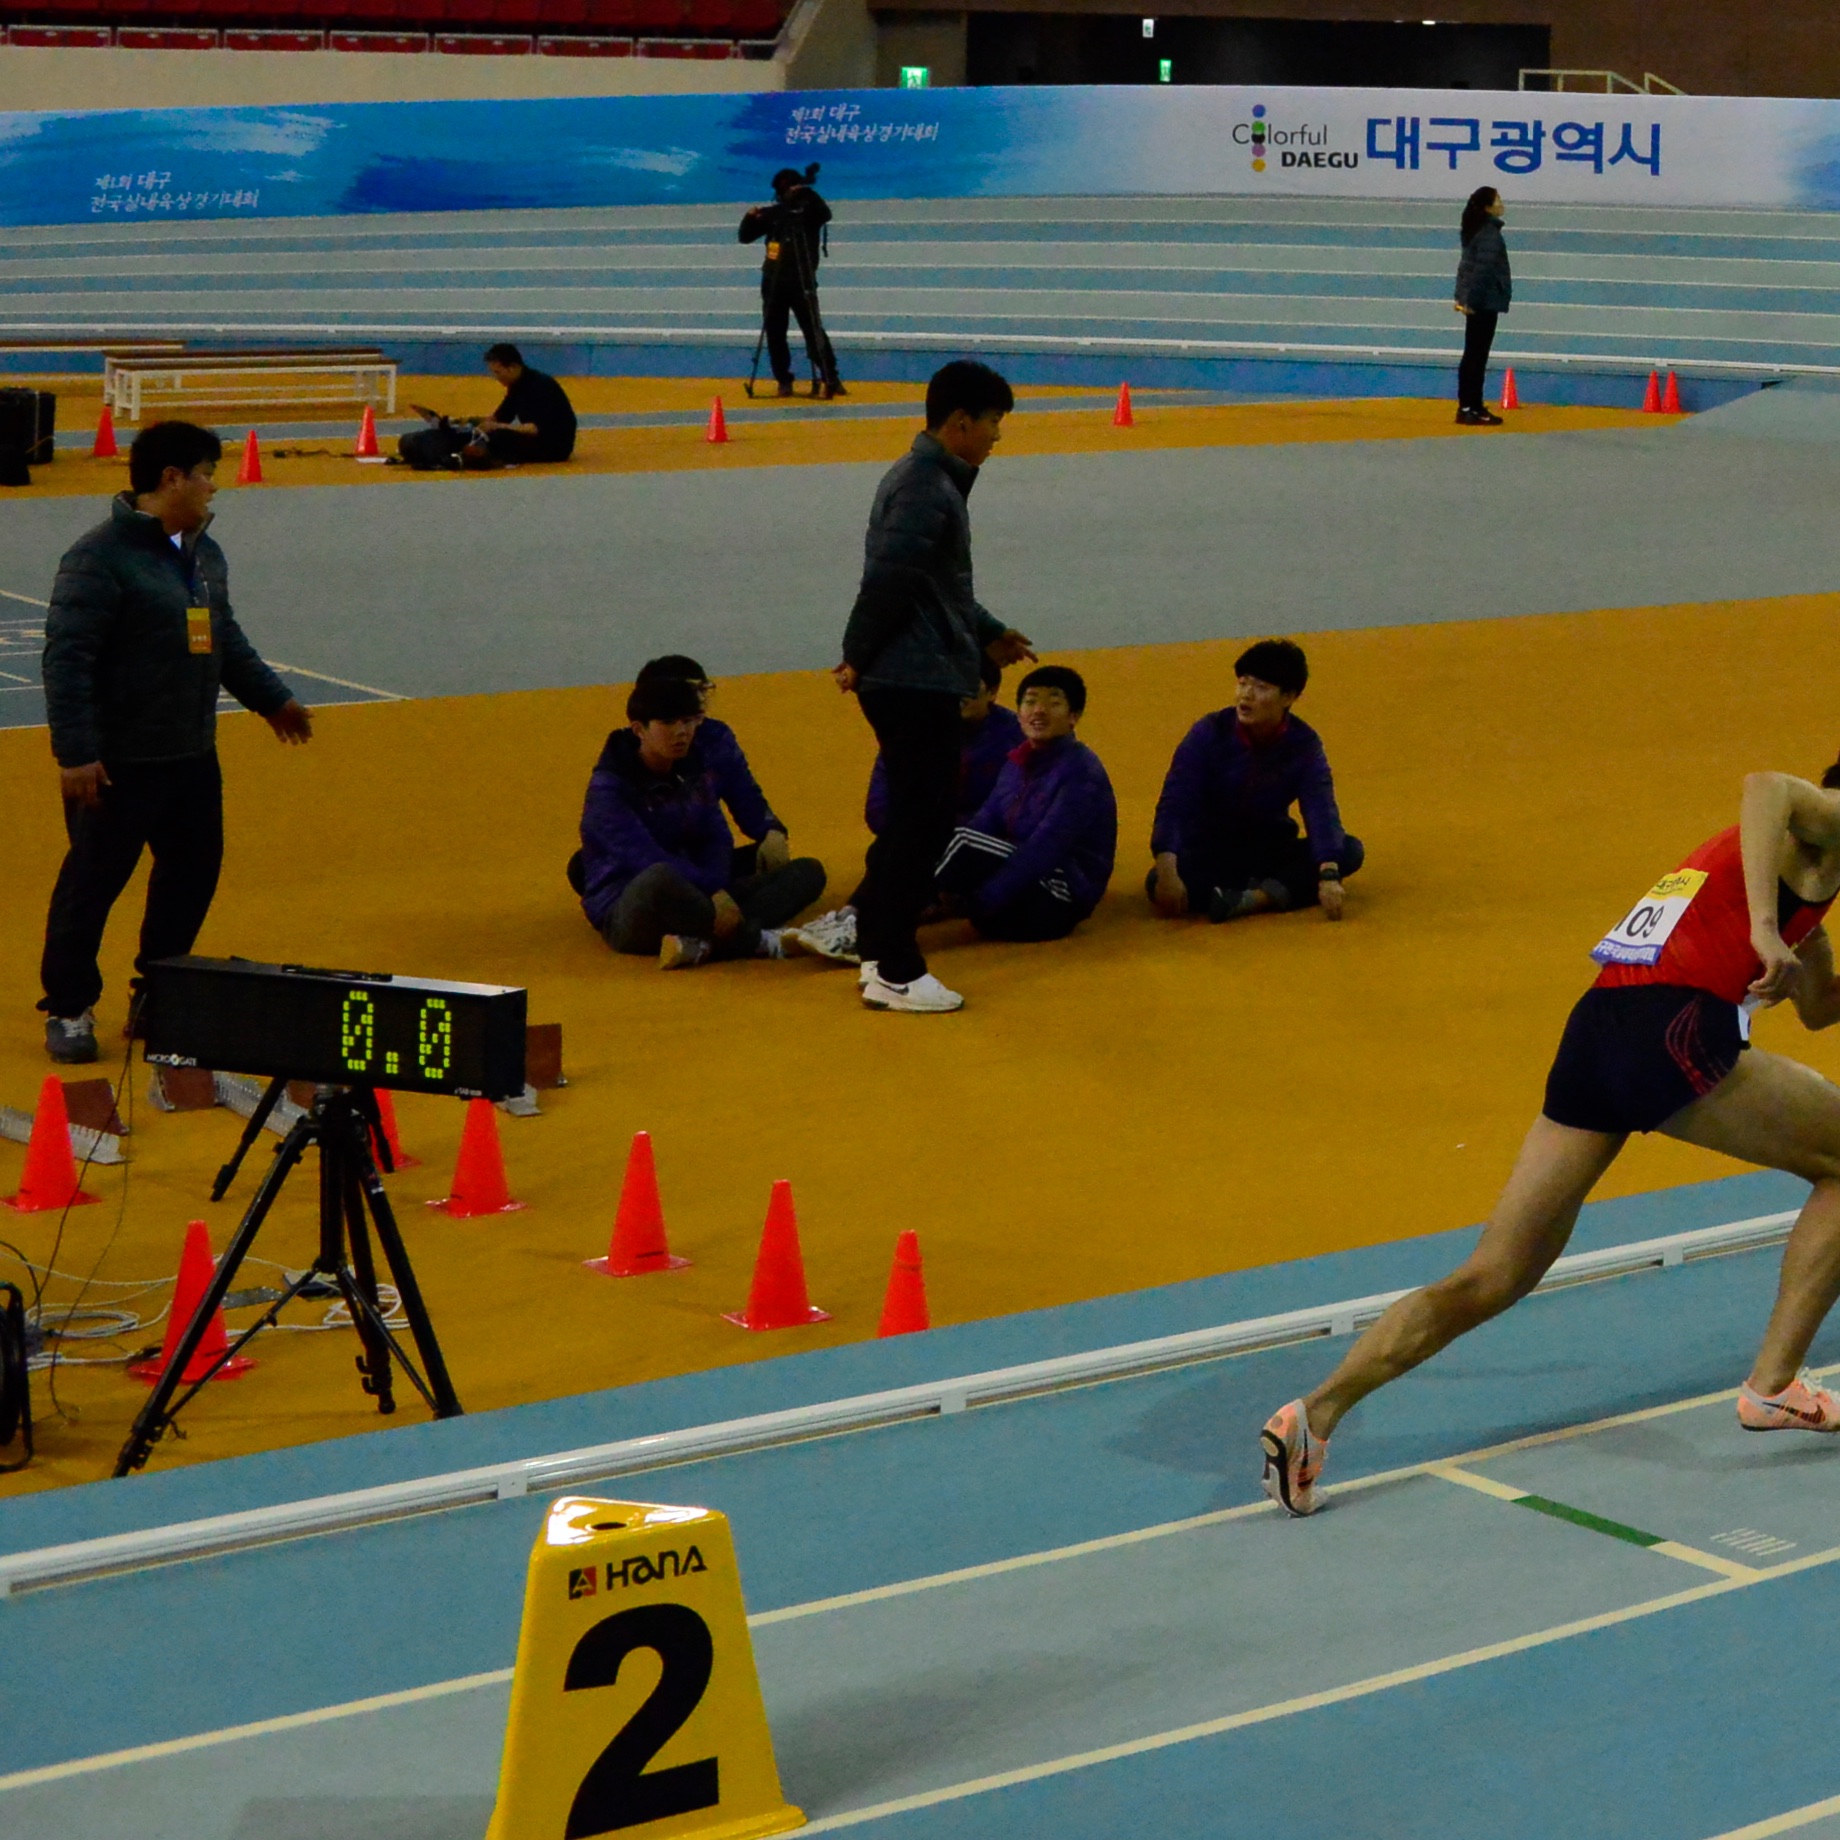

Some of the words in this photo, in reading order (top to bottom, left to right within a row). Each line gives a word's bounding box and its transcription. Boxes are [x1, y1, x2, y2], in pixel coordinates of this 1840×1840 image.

[829, 102, 861, 122] 대구
[785, 122, 939, 145] 전국실내육상경기대회
[1365, 116, 1662, 177] 대구광역시
[1280, 150, 1360, 170] DAEGU
[137, 170, 172, 191] 대구
[342, 990, 452, 1079] 0.0
[563, 1603, 720, 1840] 2
